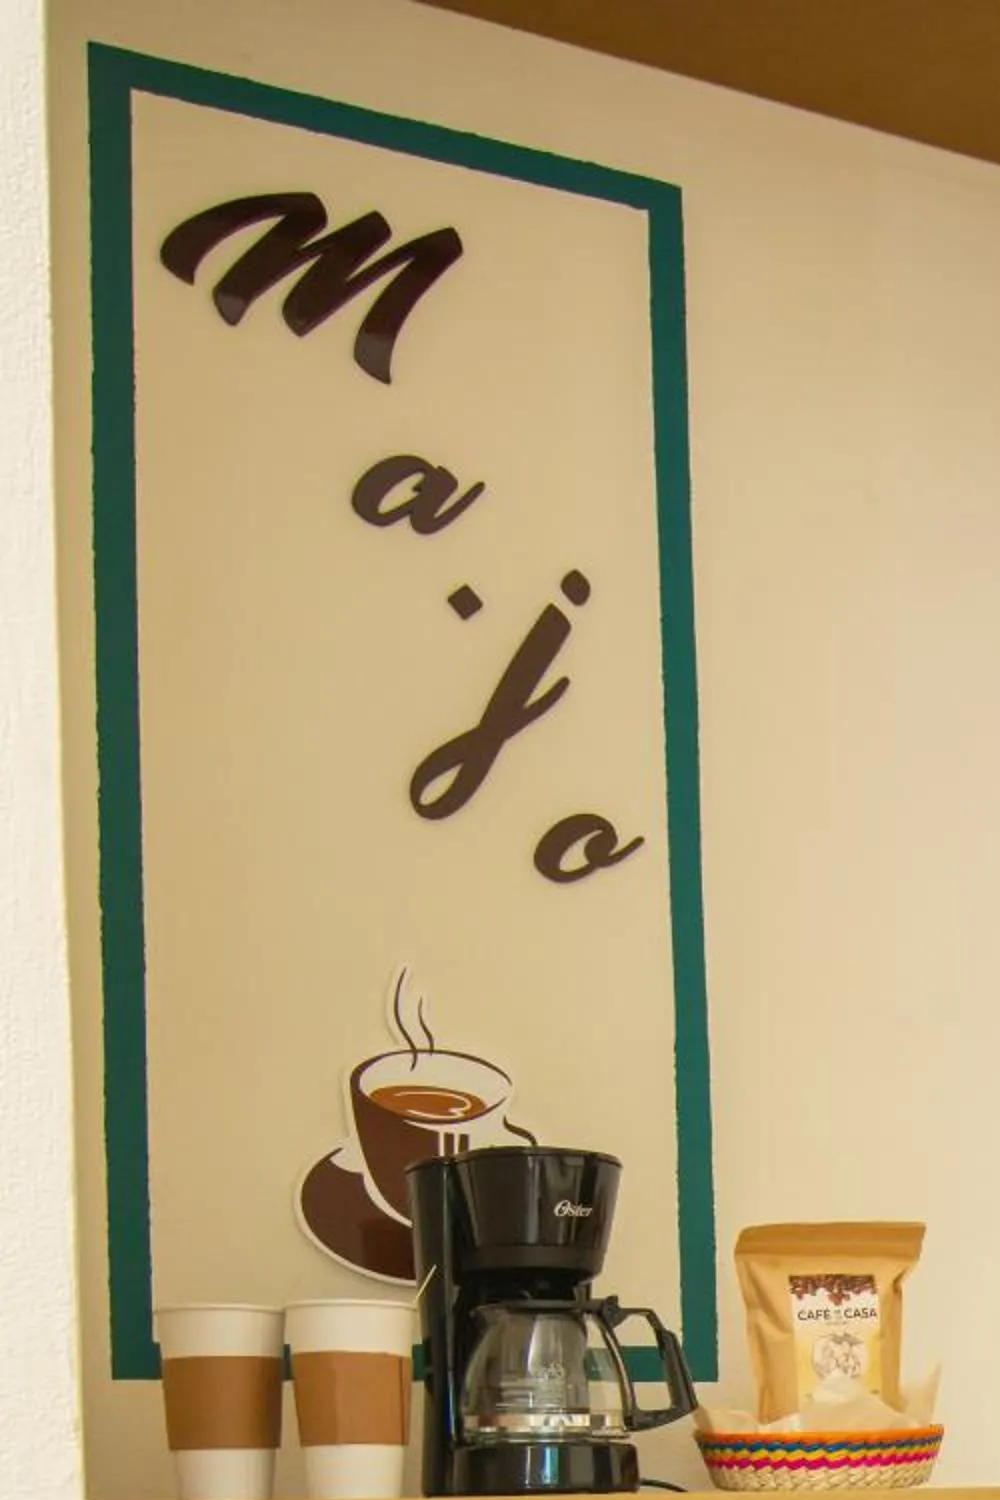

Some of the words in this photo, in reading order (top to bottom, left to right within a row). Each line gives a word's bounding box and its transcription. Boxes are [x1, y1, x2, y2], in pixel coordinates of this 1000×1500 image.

[553, 1199, 593, 1217] Oster
[797, 1306, 831, 1321] CAFÉ
[843, 1307, 877, 1319] CASA
